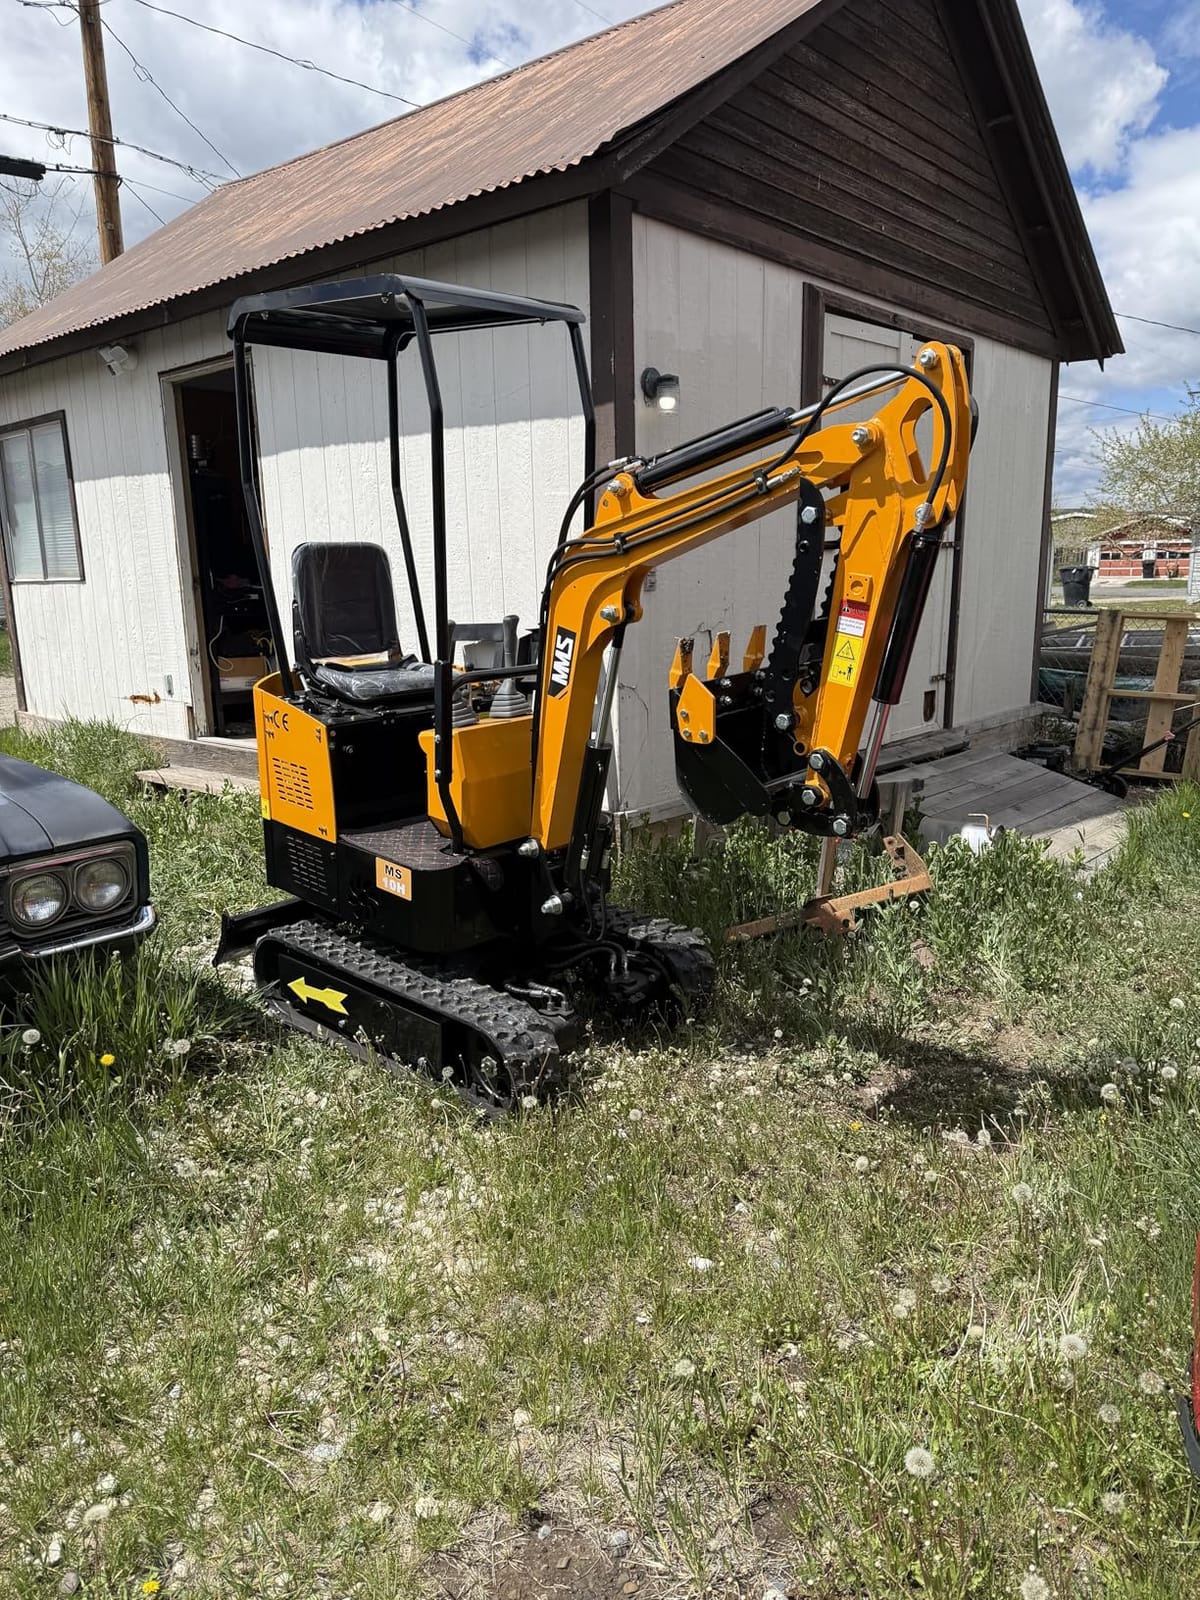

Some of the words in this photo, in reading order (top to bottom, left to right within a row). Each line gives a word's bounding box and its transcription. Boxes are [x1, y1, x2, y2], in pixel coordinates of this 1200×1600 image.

[551, 633, 575, 687] MMS
[273, 710, 289, 732] CE
[385, 864, 402, 880] MS
